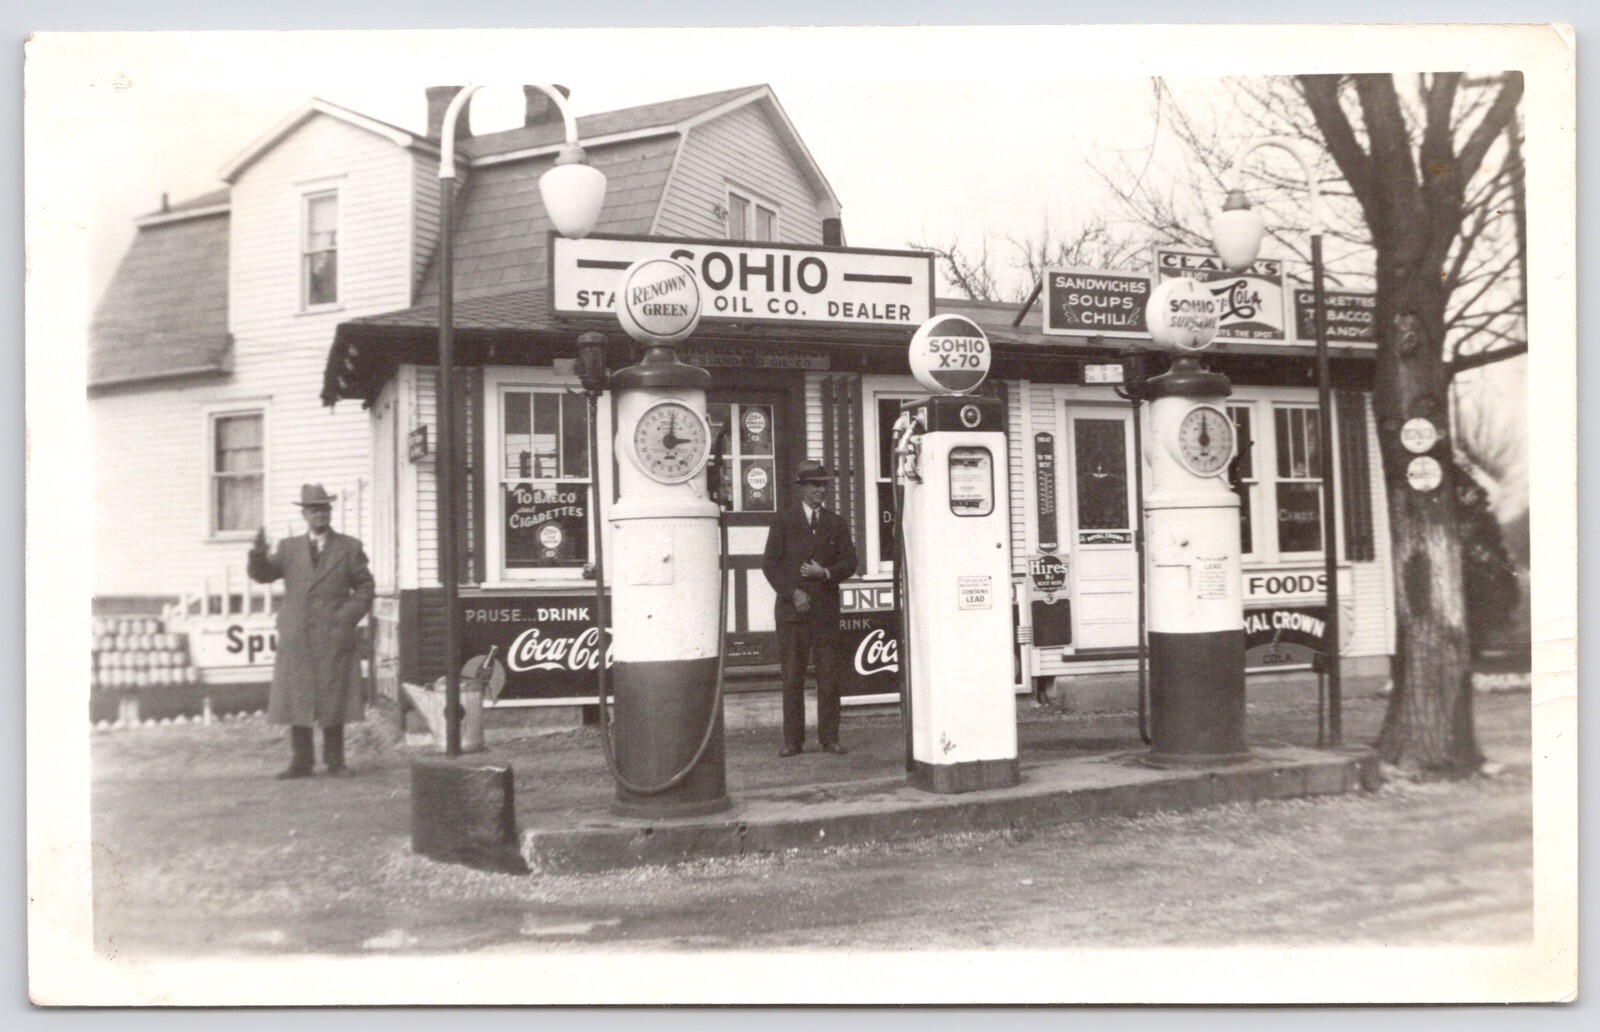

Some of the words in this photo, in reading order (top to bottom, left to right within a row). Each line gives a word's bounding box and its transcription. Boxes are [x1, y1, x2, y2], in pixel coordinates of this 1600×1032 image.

[1162, 254, 1278, 276] CLA'S
[632, 274, 687, 306] RENOWN
[1054, 276, 1147, 294] SANDWICHES
[713, 295, 754, 313] OIL
[767, 298, 807, 317] CO.
[827, 301, 911, 322] DEALER
[1068, 293, 1134, 309] SOUPS
[1170, 299, 1215, 314] SOHIO
[642, 303, 688, 317] GREEN
[1306, 308, 1372, 323] TBACCO
[1081, 311, 1126, 326] CHILI
[1235, 329, 1251, 338] THE
[1253, 330, 1273, 339] SPOT
[1325, 325, 1368, 337] ANDY
[929, 339, 985, 354] SOHIO
[939, 354, 980, 368] X-70
[509, 506, 584, 529] CIGARETTES
[1029, 558, 1068, 575] Hires
[840, 588, 892, 610] UNC
[966, 595, 985, 603] LEAD
[537, 607, 590, 622] DRINK
[839, 618, 871, 631] RINK
[1243, 612, 1271, 635] YAL
[1272, 611, 1326, 639] CROWN
[1262, 653, 1293, 664] COLA
